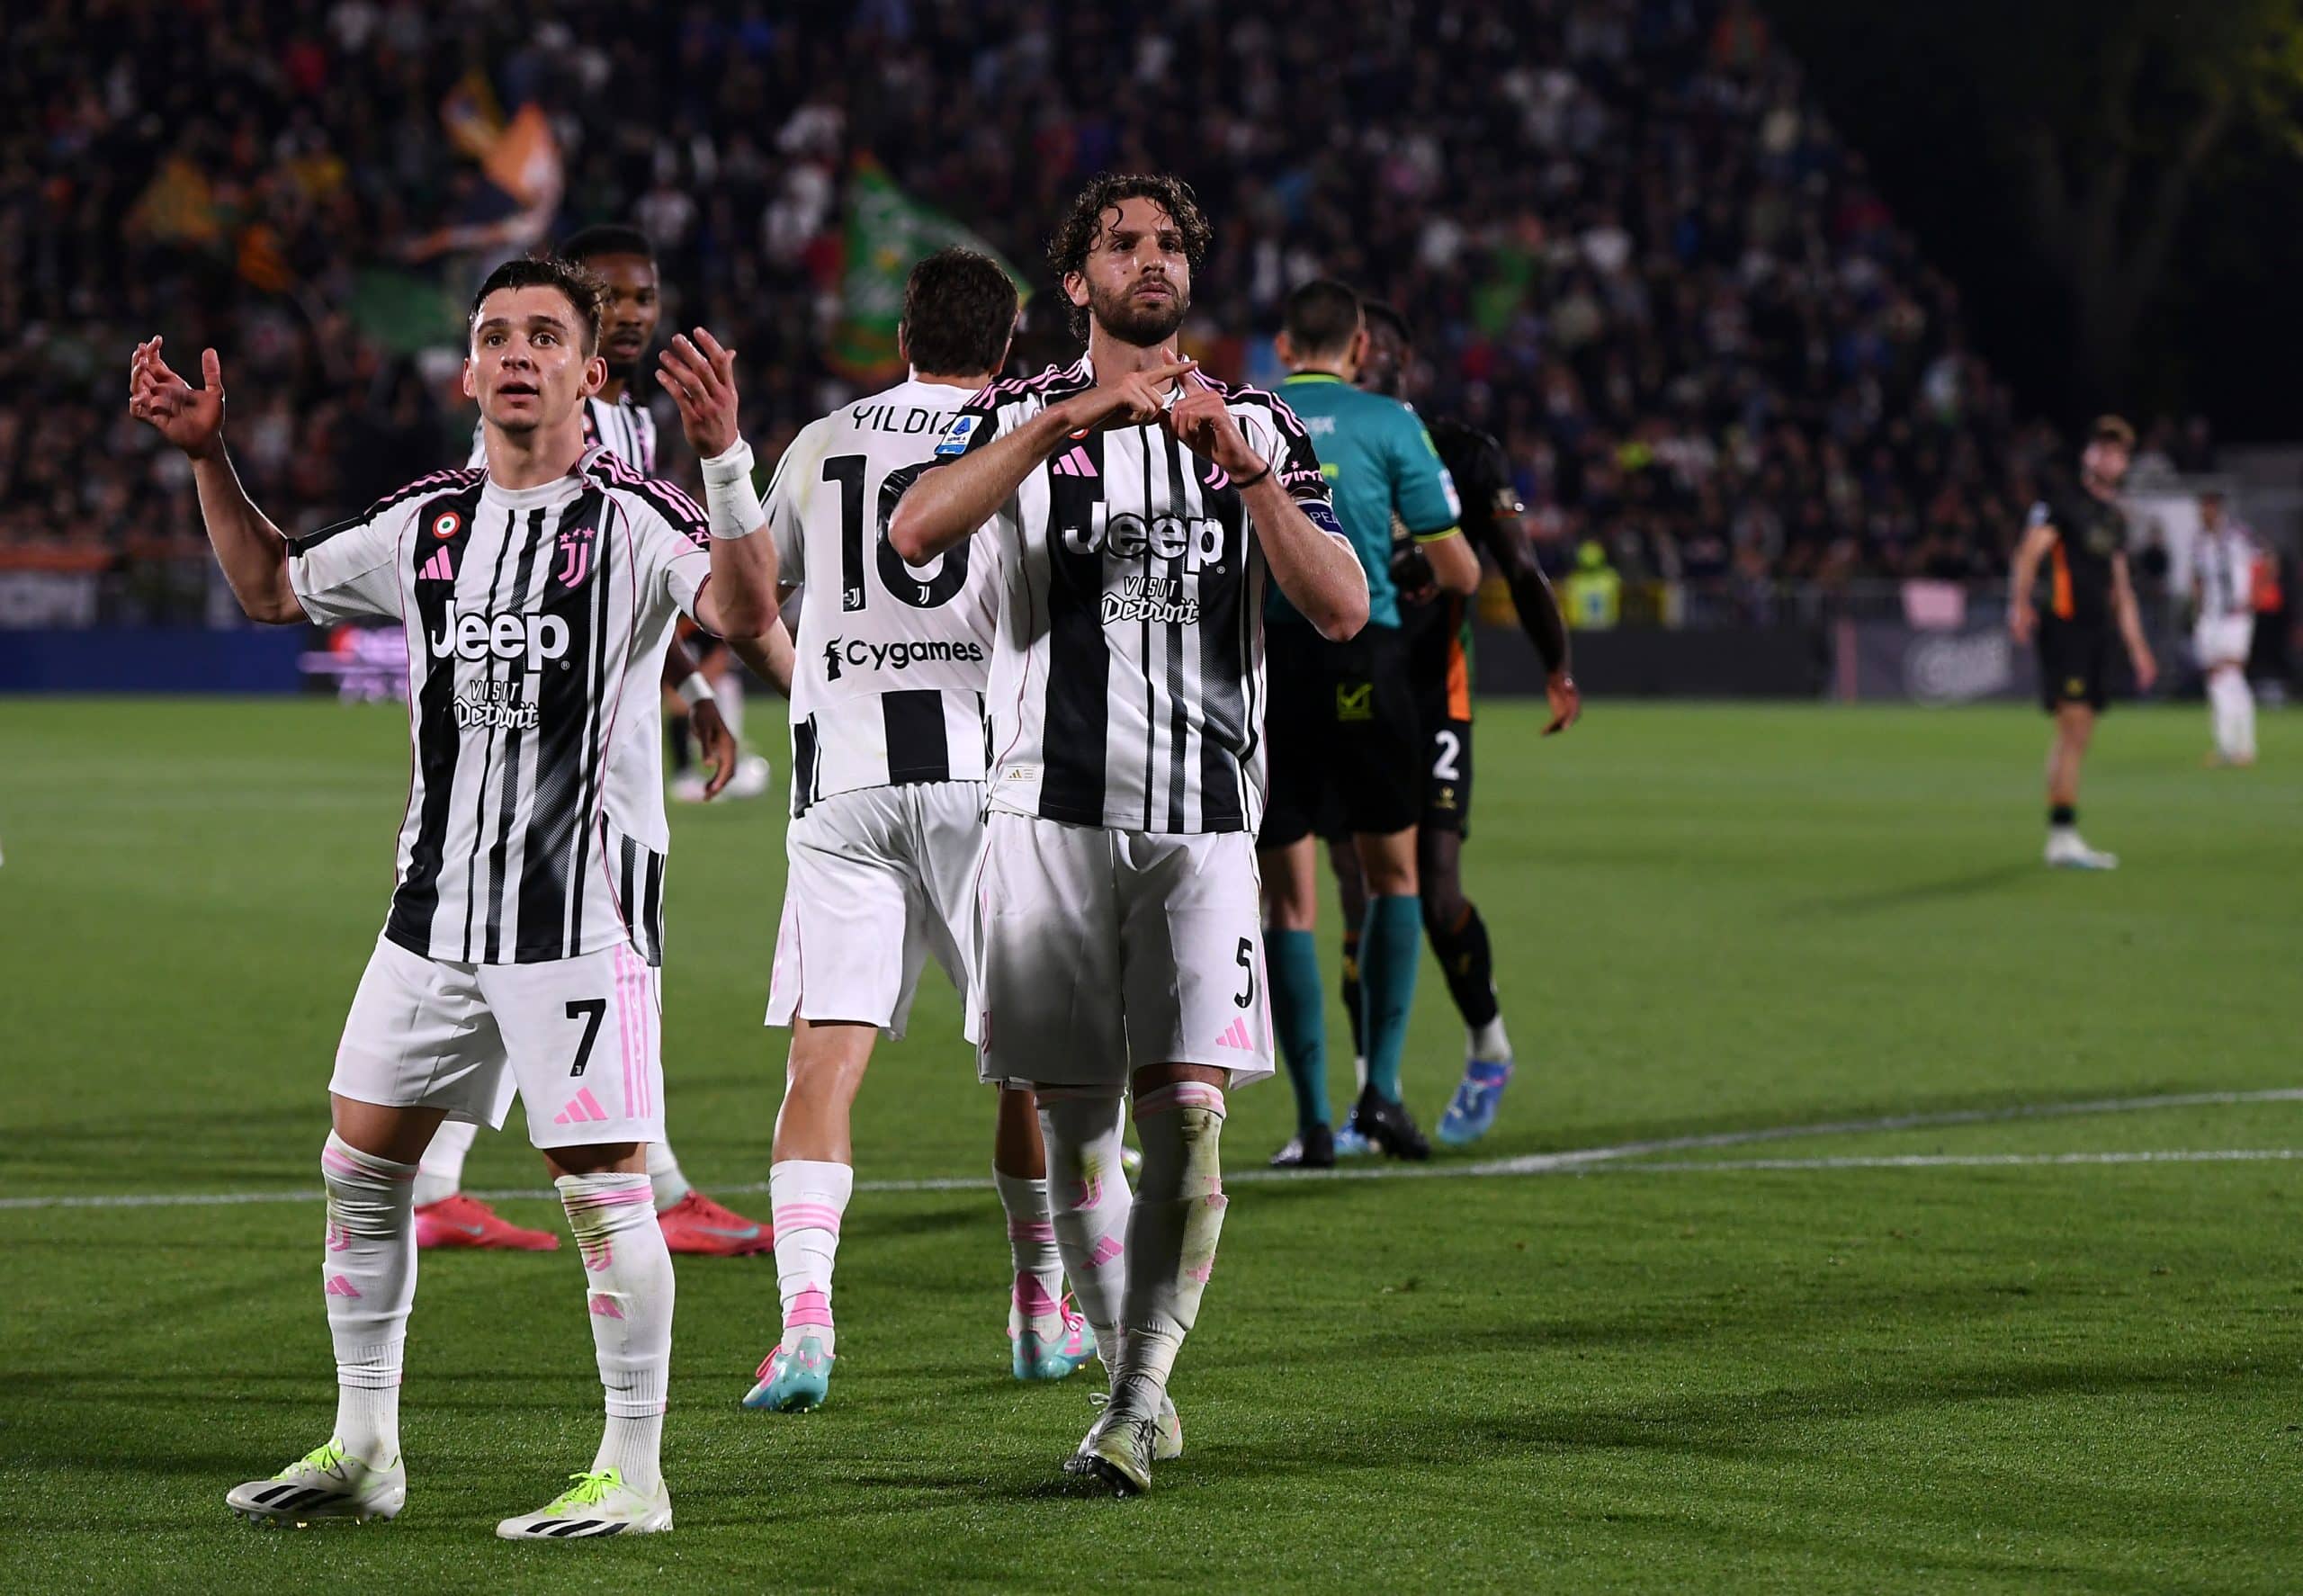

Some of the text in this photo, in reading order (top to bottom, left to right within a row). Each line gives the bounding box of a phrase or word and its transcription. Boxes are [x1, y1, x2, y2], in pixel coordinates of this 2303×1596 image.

[822, 454, 972, 613] 10
[1064, 499, 1225, 573] Jeep
[1101, 591, 1201, 625] Detroit
[1124, 576, 1178, 598] VISIT
[431, 599, 570, 671] Jeep
[846, 640, 984, 671] Cygames
[453, 695, 541, 730] Detroit
[469, 679, 521, 703] VISIT
[1432, 729, 1461, 781] 2
[1233, 936, 1254, 1009] 5
[565, 997, 607, 1078] 7
